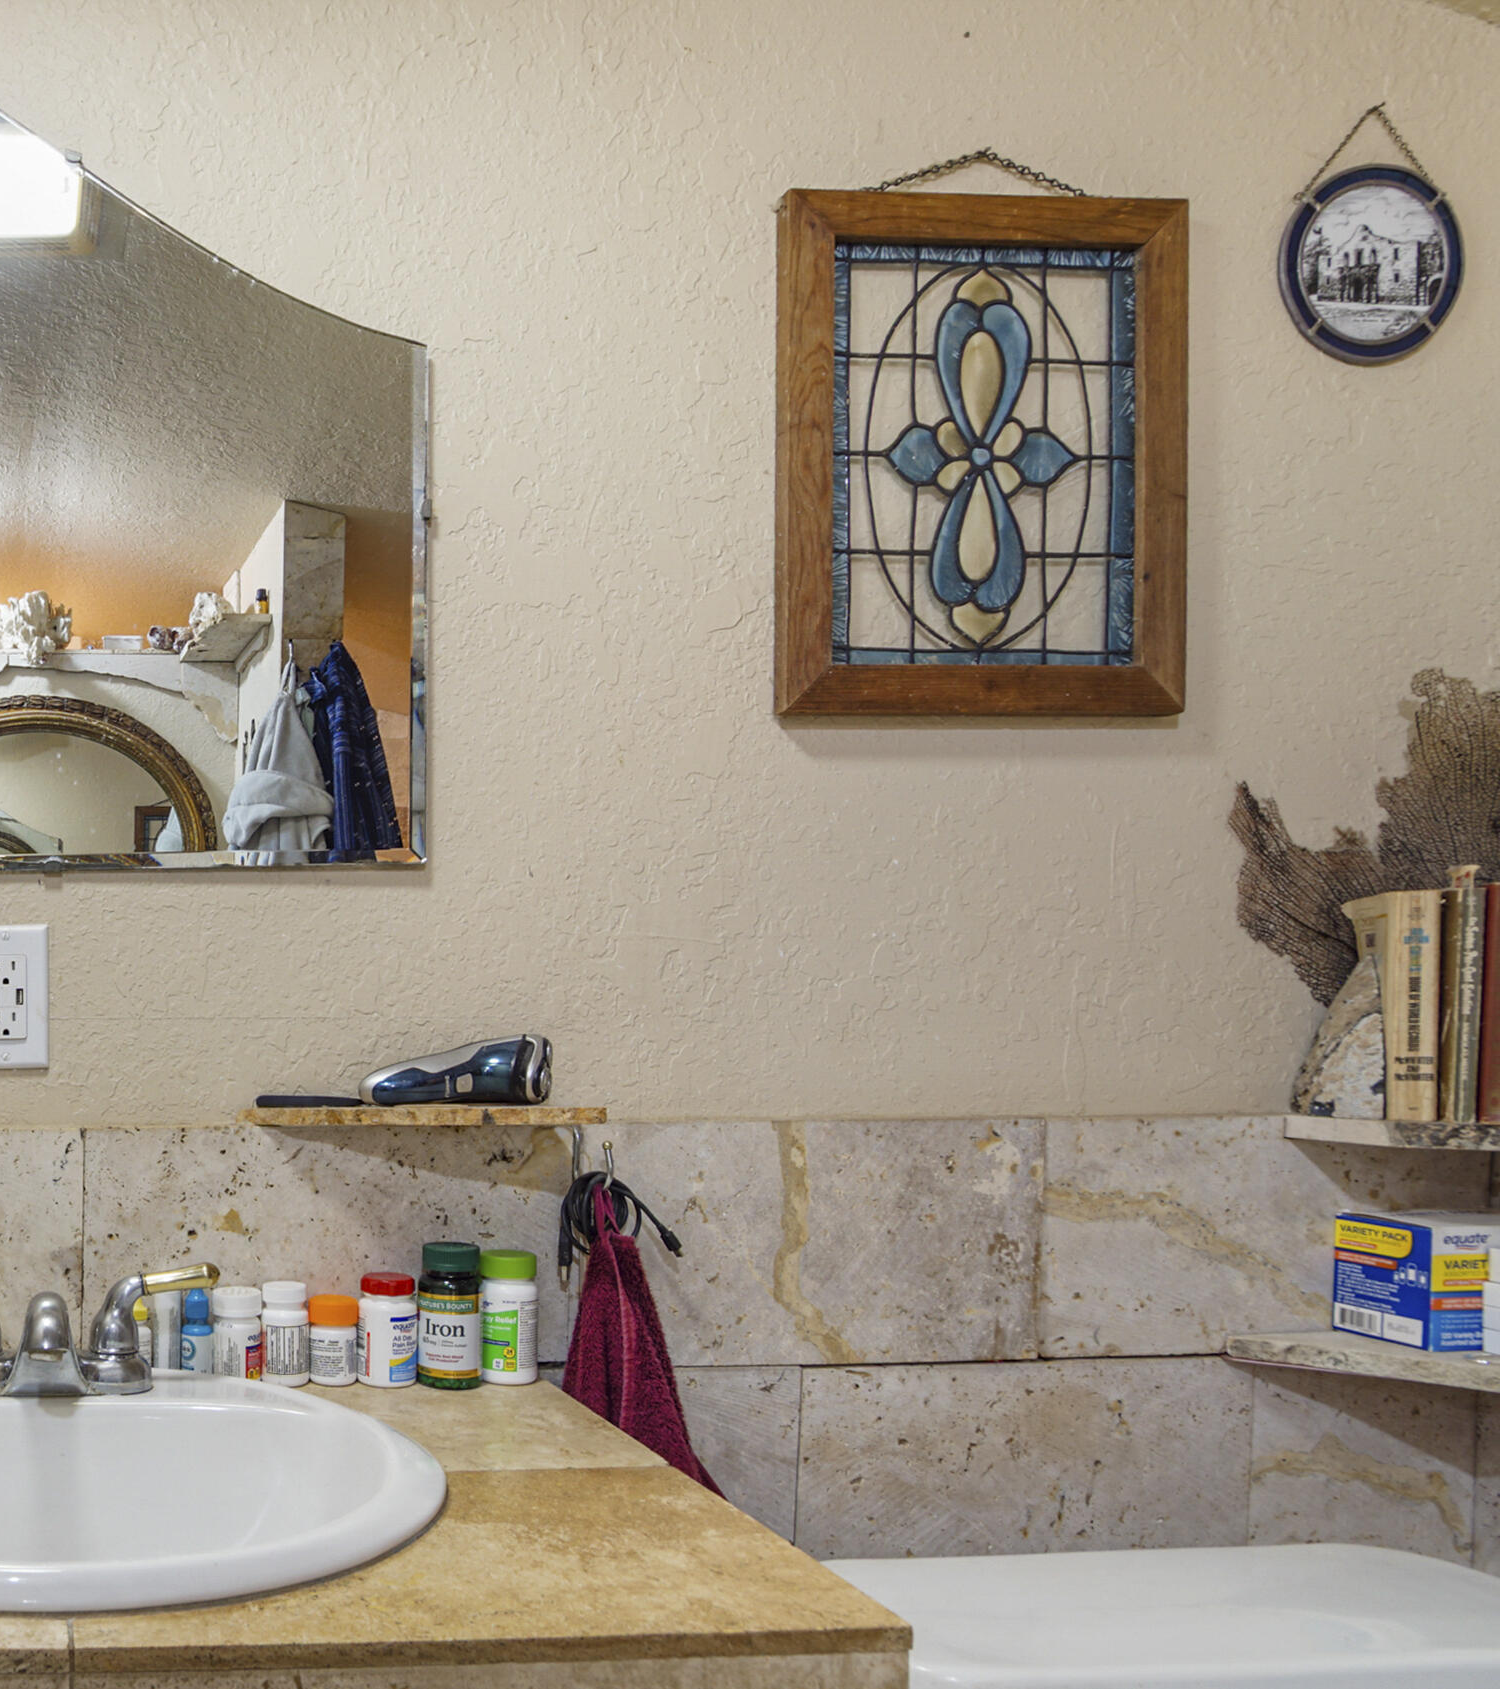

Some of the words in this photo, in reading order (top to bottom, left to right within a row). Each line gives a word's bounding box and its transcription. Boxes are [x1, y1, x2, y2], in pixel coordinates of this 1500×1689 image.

[1340, 1224, 1379, 1237] VARIETY
[1381, 1231, 1408, 1242] PACK
[1443, 1233, 1488, 1248] equate
[1443, 1260, 1488, 1270] VARIET
[425, 1318, 466, 1338] Iron
